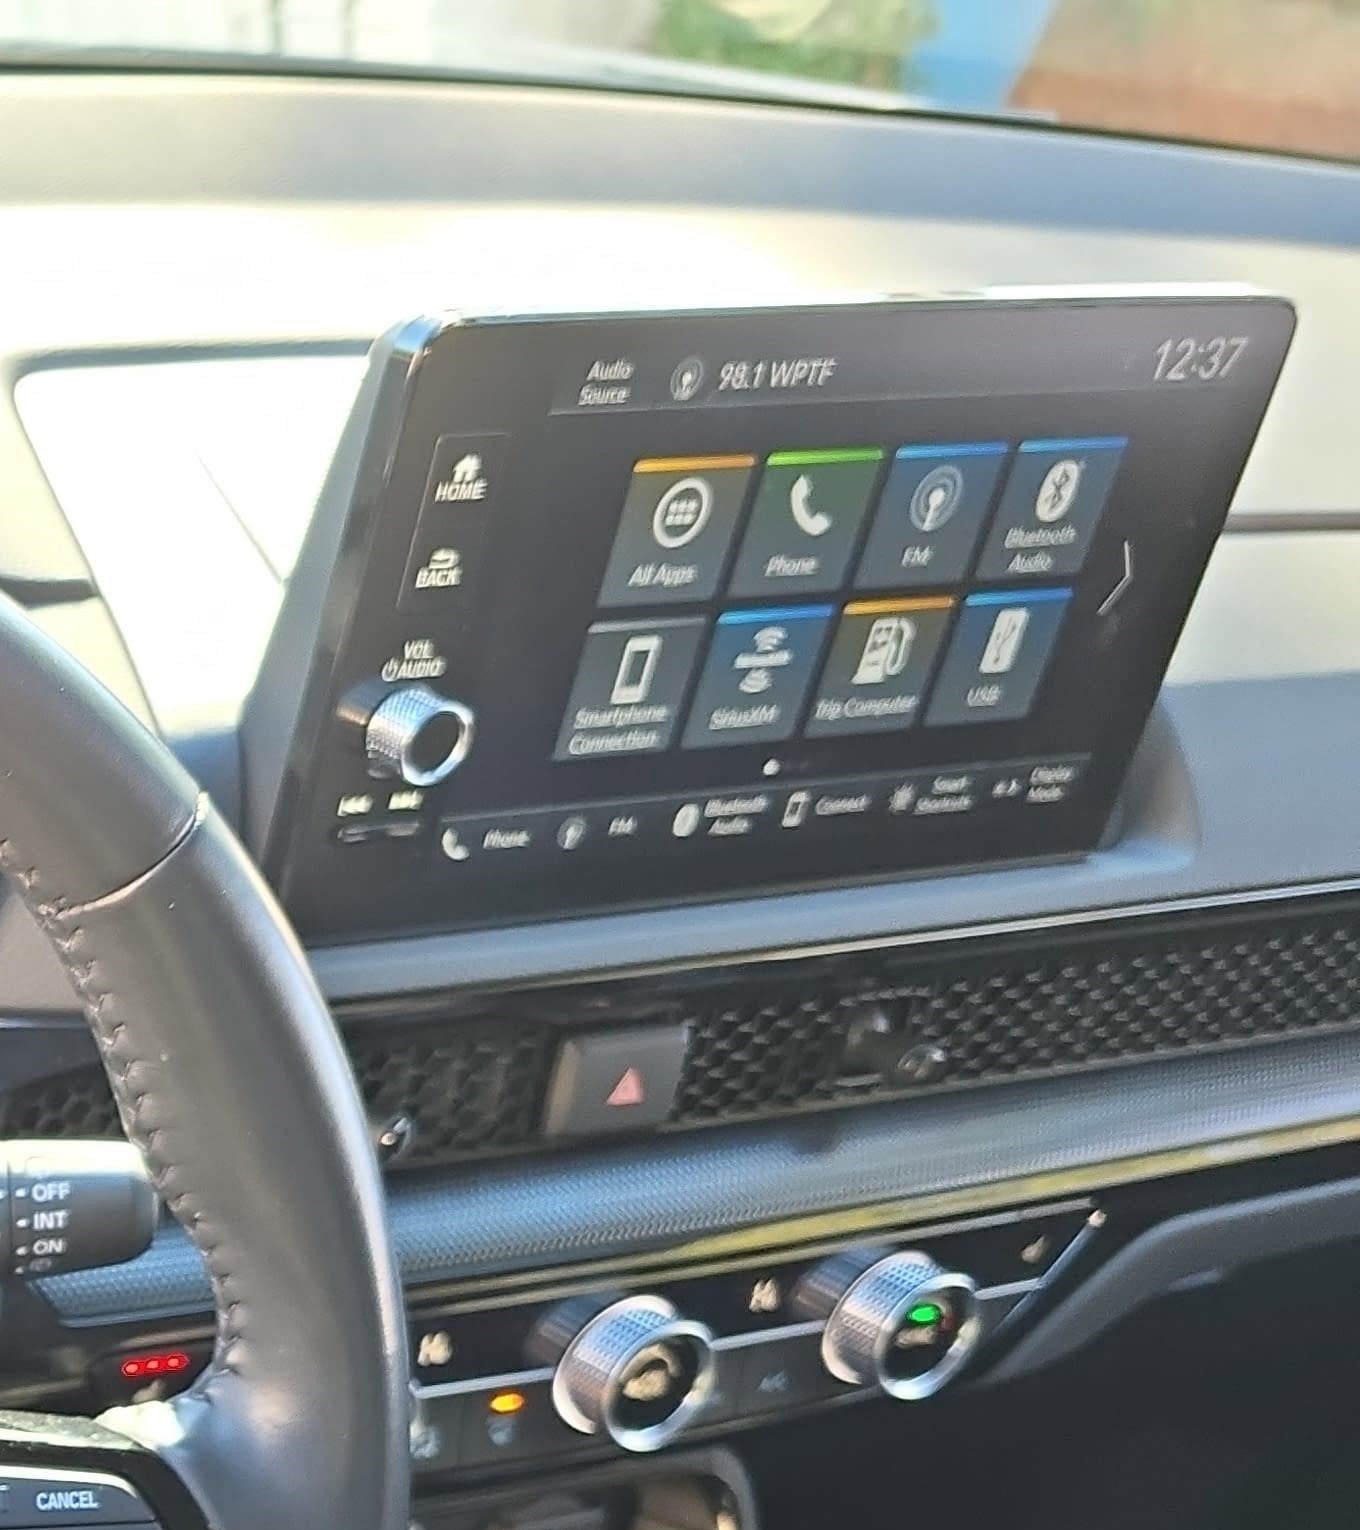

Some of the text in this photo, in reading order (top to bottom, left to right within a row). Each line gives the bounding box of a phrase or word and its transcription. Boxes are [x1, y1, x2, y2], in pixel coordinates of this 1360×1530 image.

[586, 359, 634, 382] Audio
[1152, 336, 1249, 383] 12:37
[718, 362, 765, 391] 98.1
[578, 386, 632, 406] Source
[434, 481, 488, 503] HOME
[1004, 525, 1077, 549] Bluetooth
[414, 565, 464, 589] BACK
[628, 565, 655, 587] All
[764, 556, 819, 577] Phone
[32, 1183, 71, 1203] OFF
[32, 1211, 66, 1230] INT
[32, 1239, 65, 1256] ON
[35, 1491, 100, 1511] CANCEL
